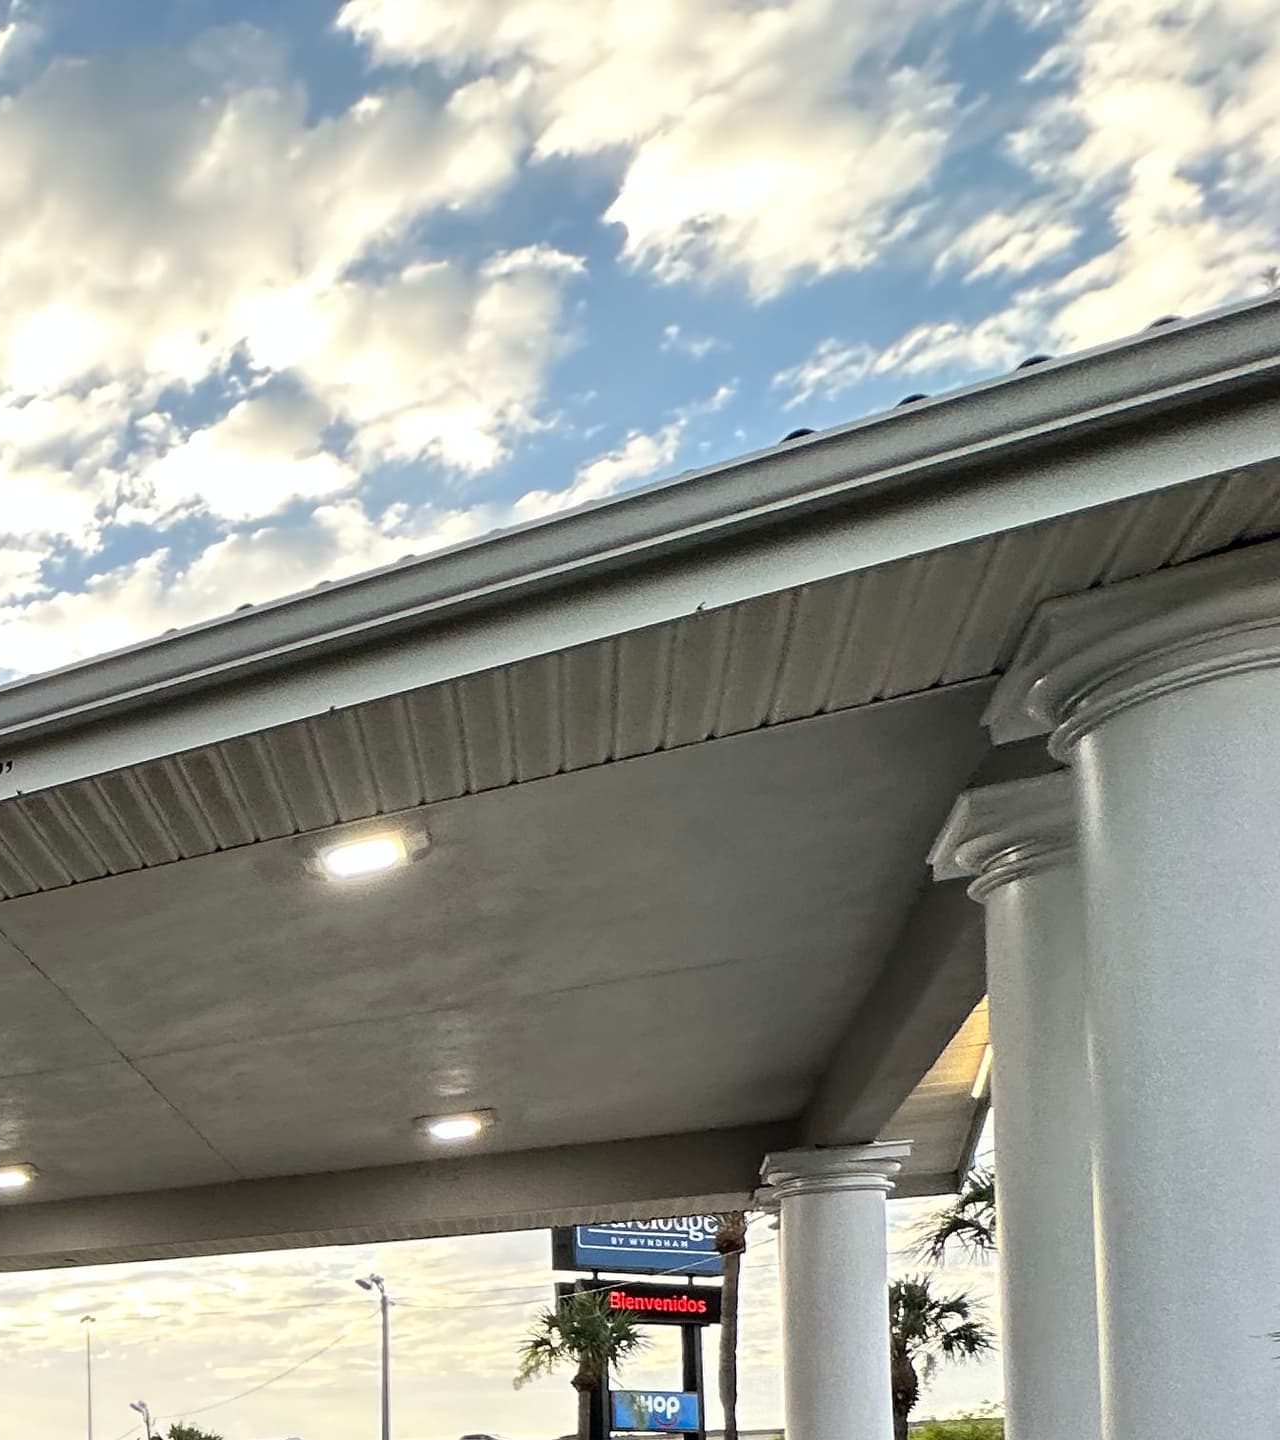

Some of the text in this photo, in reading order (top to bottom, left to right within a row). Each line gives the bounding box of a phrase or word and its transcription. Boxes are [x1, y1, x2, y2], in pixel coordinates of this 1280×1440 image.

[610, 1236, 689, 1248] BY WYNDHAM
[608, 1291, 707, 1313] Bienvenidos
